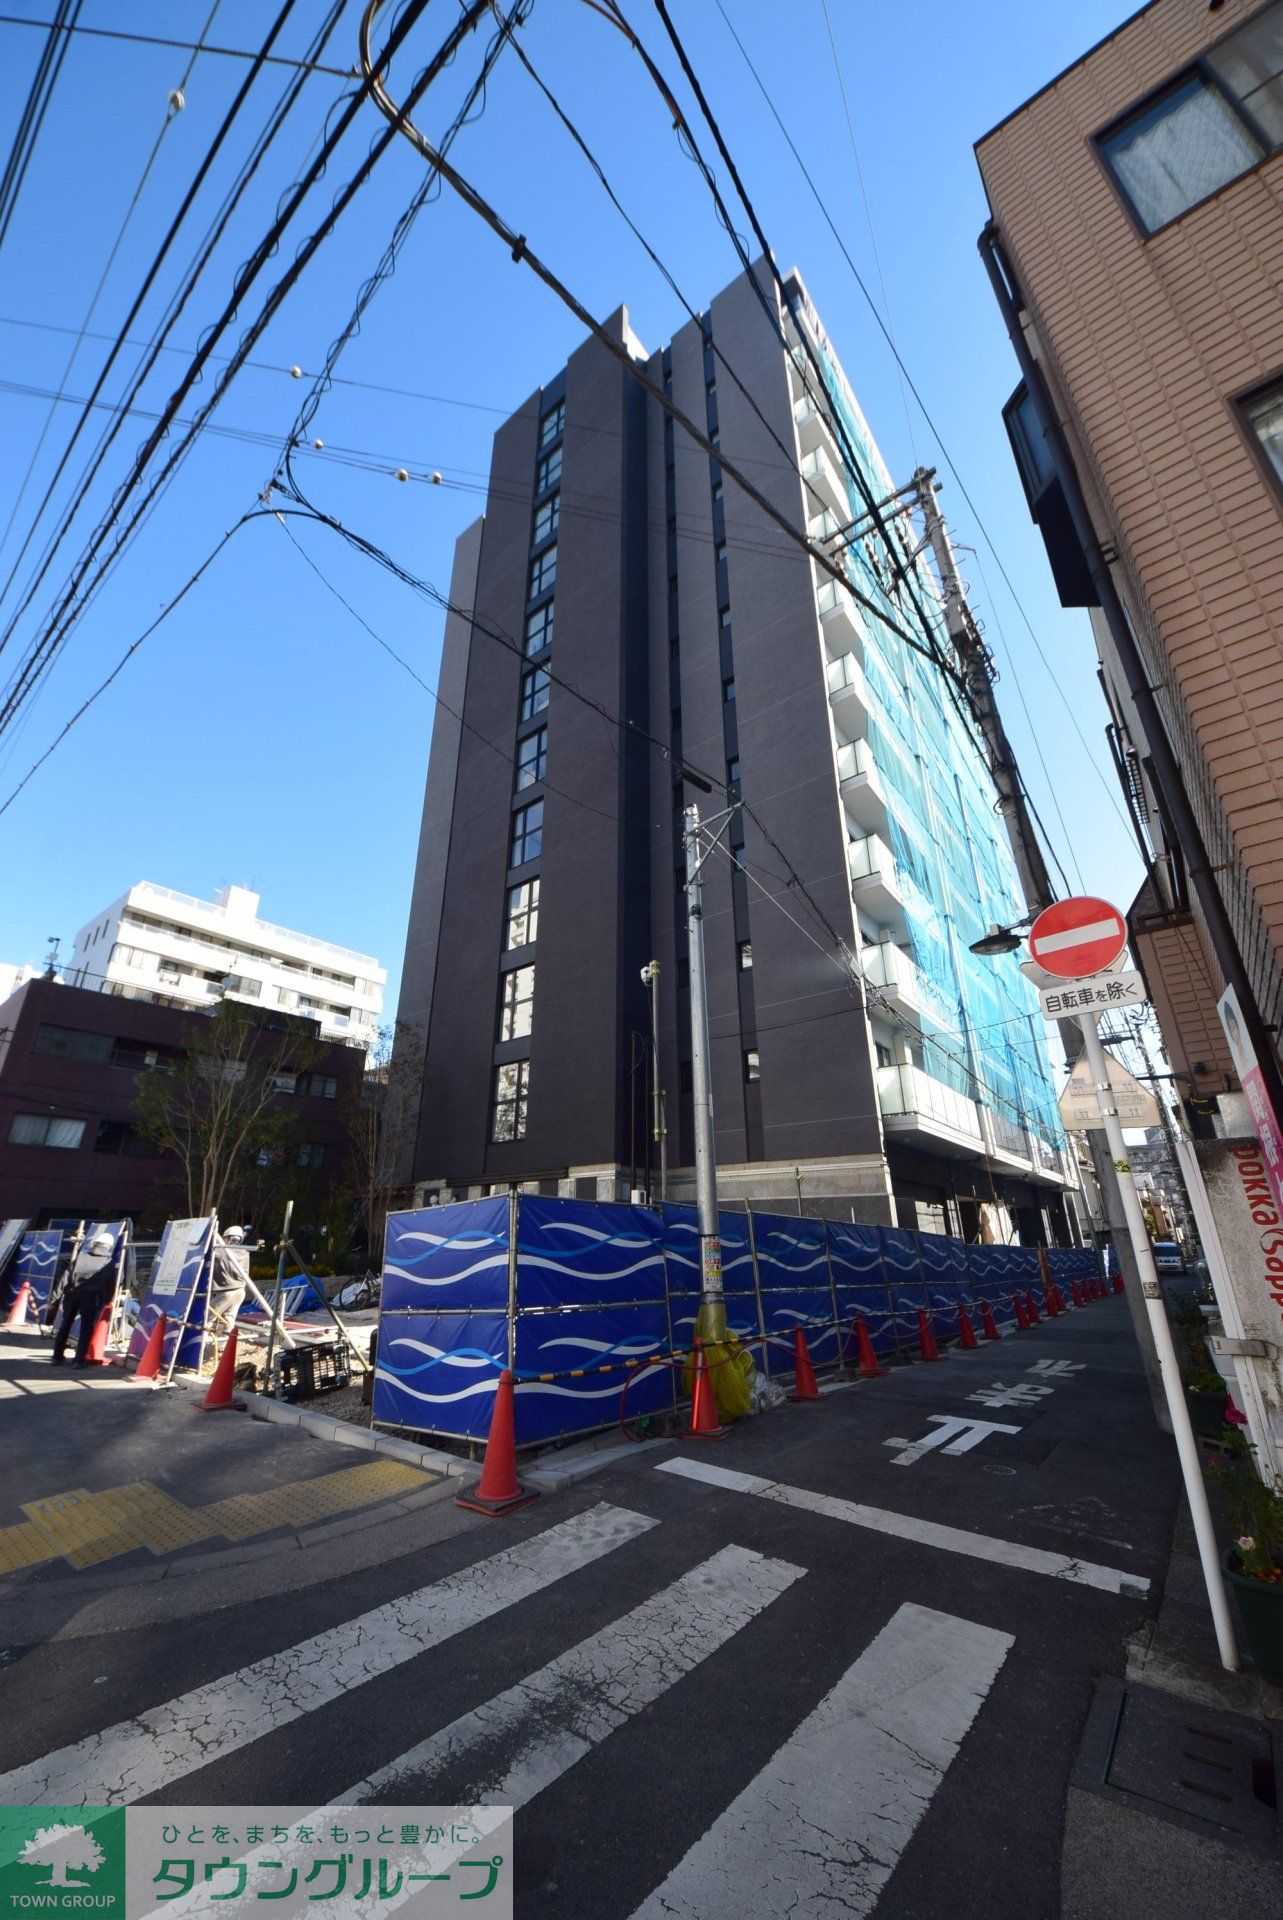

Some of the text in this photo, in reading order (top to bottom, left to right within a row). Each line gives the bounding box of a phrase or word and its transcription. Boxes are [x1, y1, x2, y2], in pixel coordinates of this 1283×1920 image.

[1045, 981, 1138, 1012] 自転車を除く
[881, 1359, 1087, 1466] 止まれ
